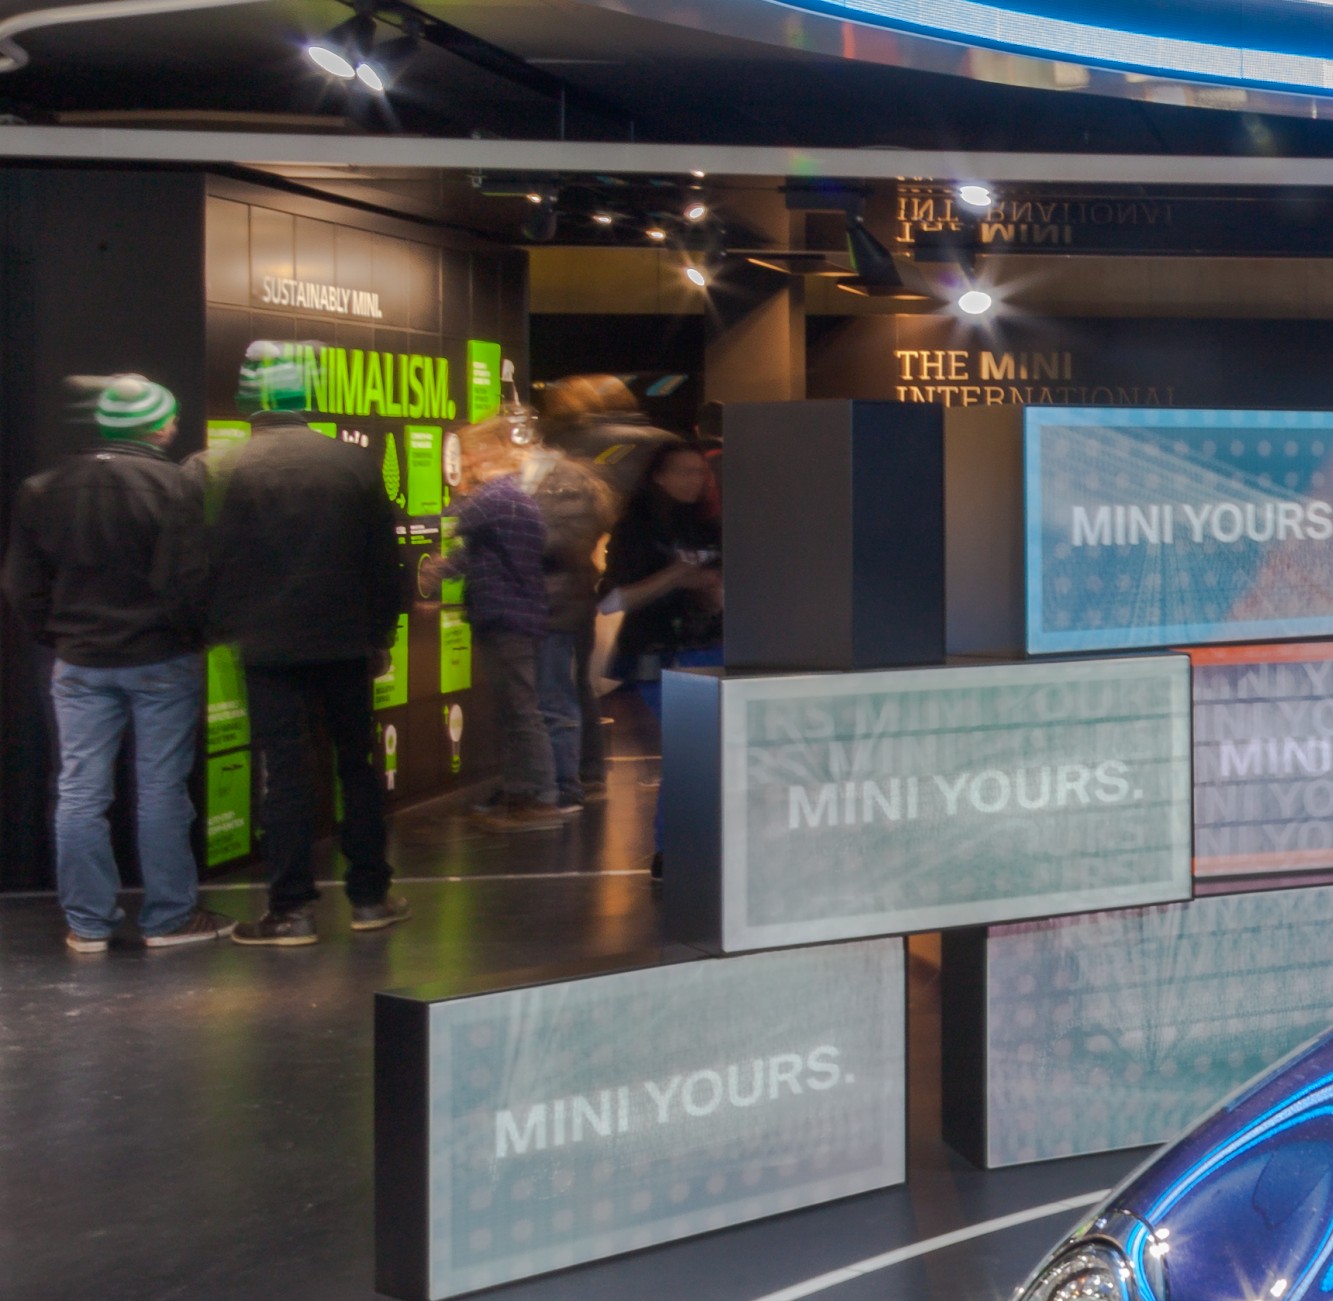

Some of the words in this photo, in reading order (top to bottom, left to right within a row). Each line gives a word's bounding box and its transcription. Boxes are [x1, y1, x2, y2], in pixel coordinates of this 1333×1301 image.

[263, 276, 350, 315] SUSTAINABLY
[351, 290, 383, 318] MINI.
[897, 350, 969, 381] THE
[980, 351, 1072, 381] MINI
[1072, 503, 1174, 547] MINI
[1219, 734, 1332, 777] MINI
[787, 775, 918, 831] MINI
[933, 758, 1144, 816] YOURS.
[494, 1085, 629, 1159] MINI
[643, 1044, 856, 1124] YOURS.
